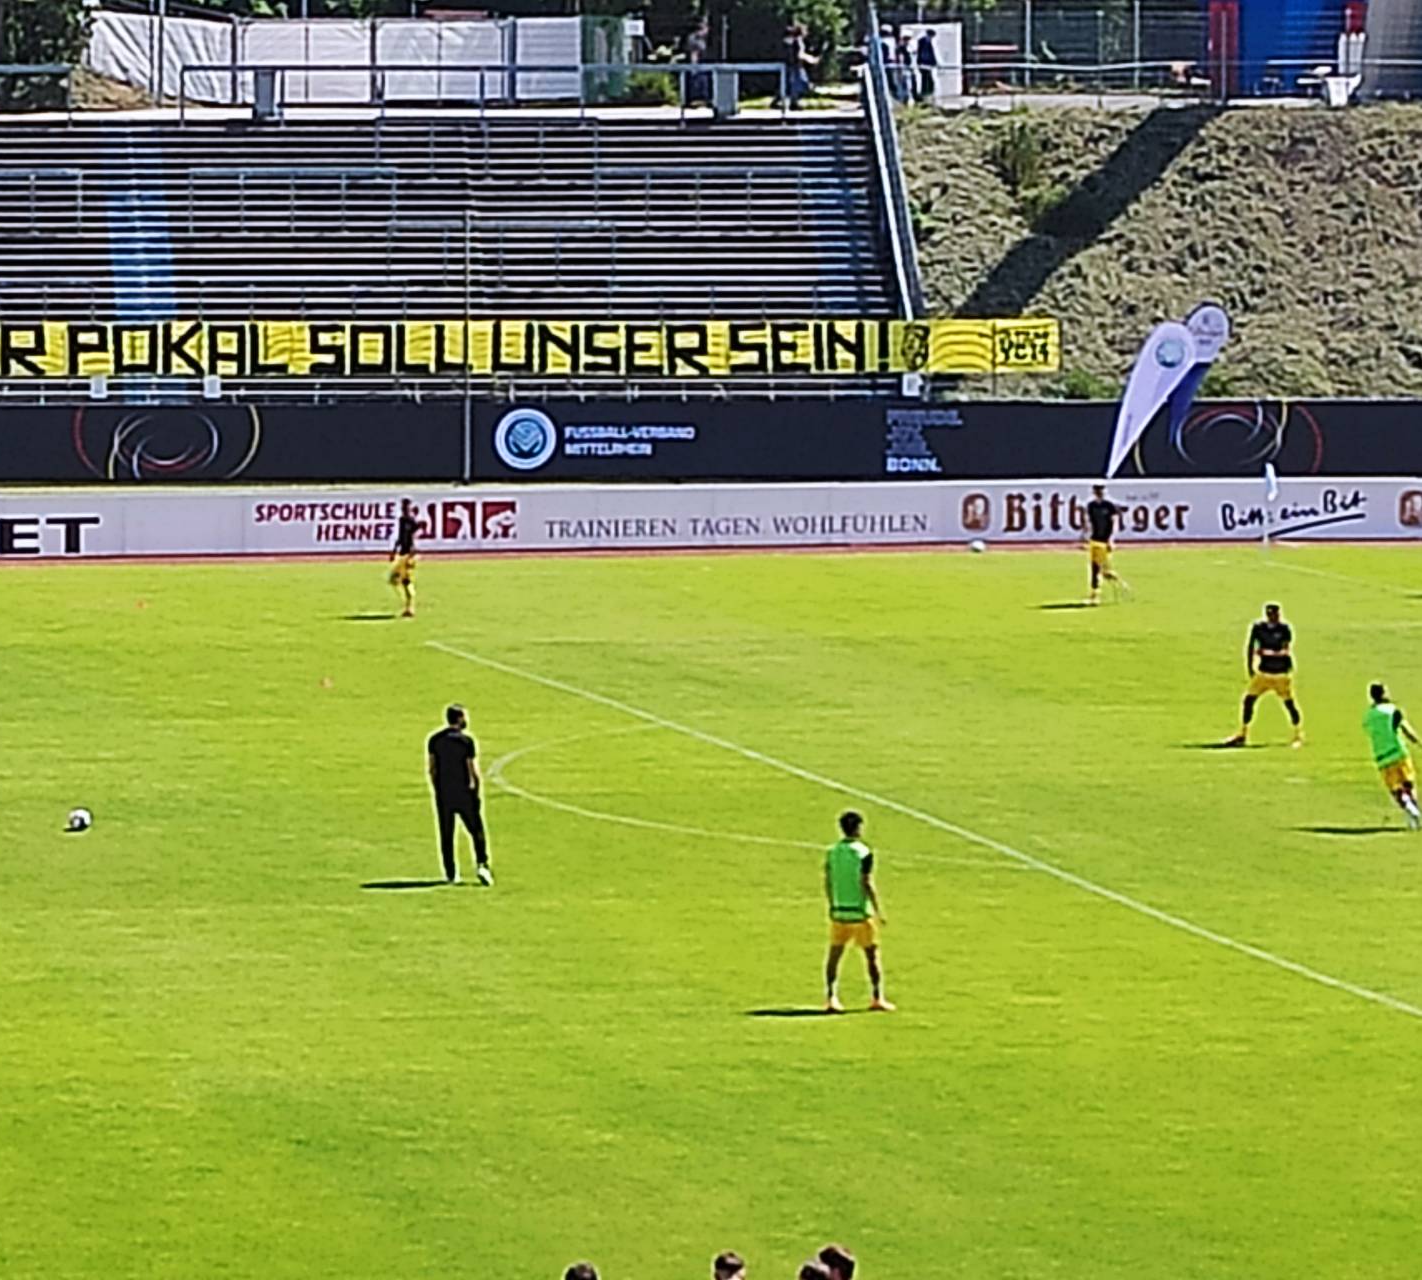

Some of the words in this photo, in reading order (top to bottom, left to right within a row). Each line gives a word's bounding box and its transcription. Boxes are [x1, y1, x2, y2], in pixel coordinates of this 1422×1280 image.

[68, 322, 289, 376] POKAL
[309, 322, 466, 374] SOLL
[491, 321, 710, 374] UNSER
[254, 502, 396, 523] SPORTSCHULE
[1003, 492, 1190, 533] Bitbrger
[1280, 501, 1320, 521] ein
[1323, 488, 1368, 514] Bit
[316, 523, 395, 542] HENNEF
